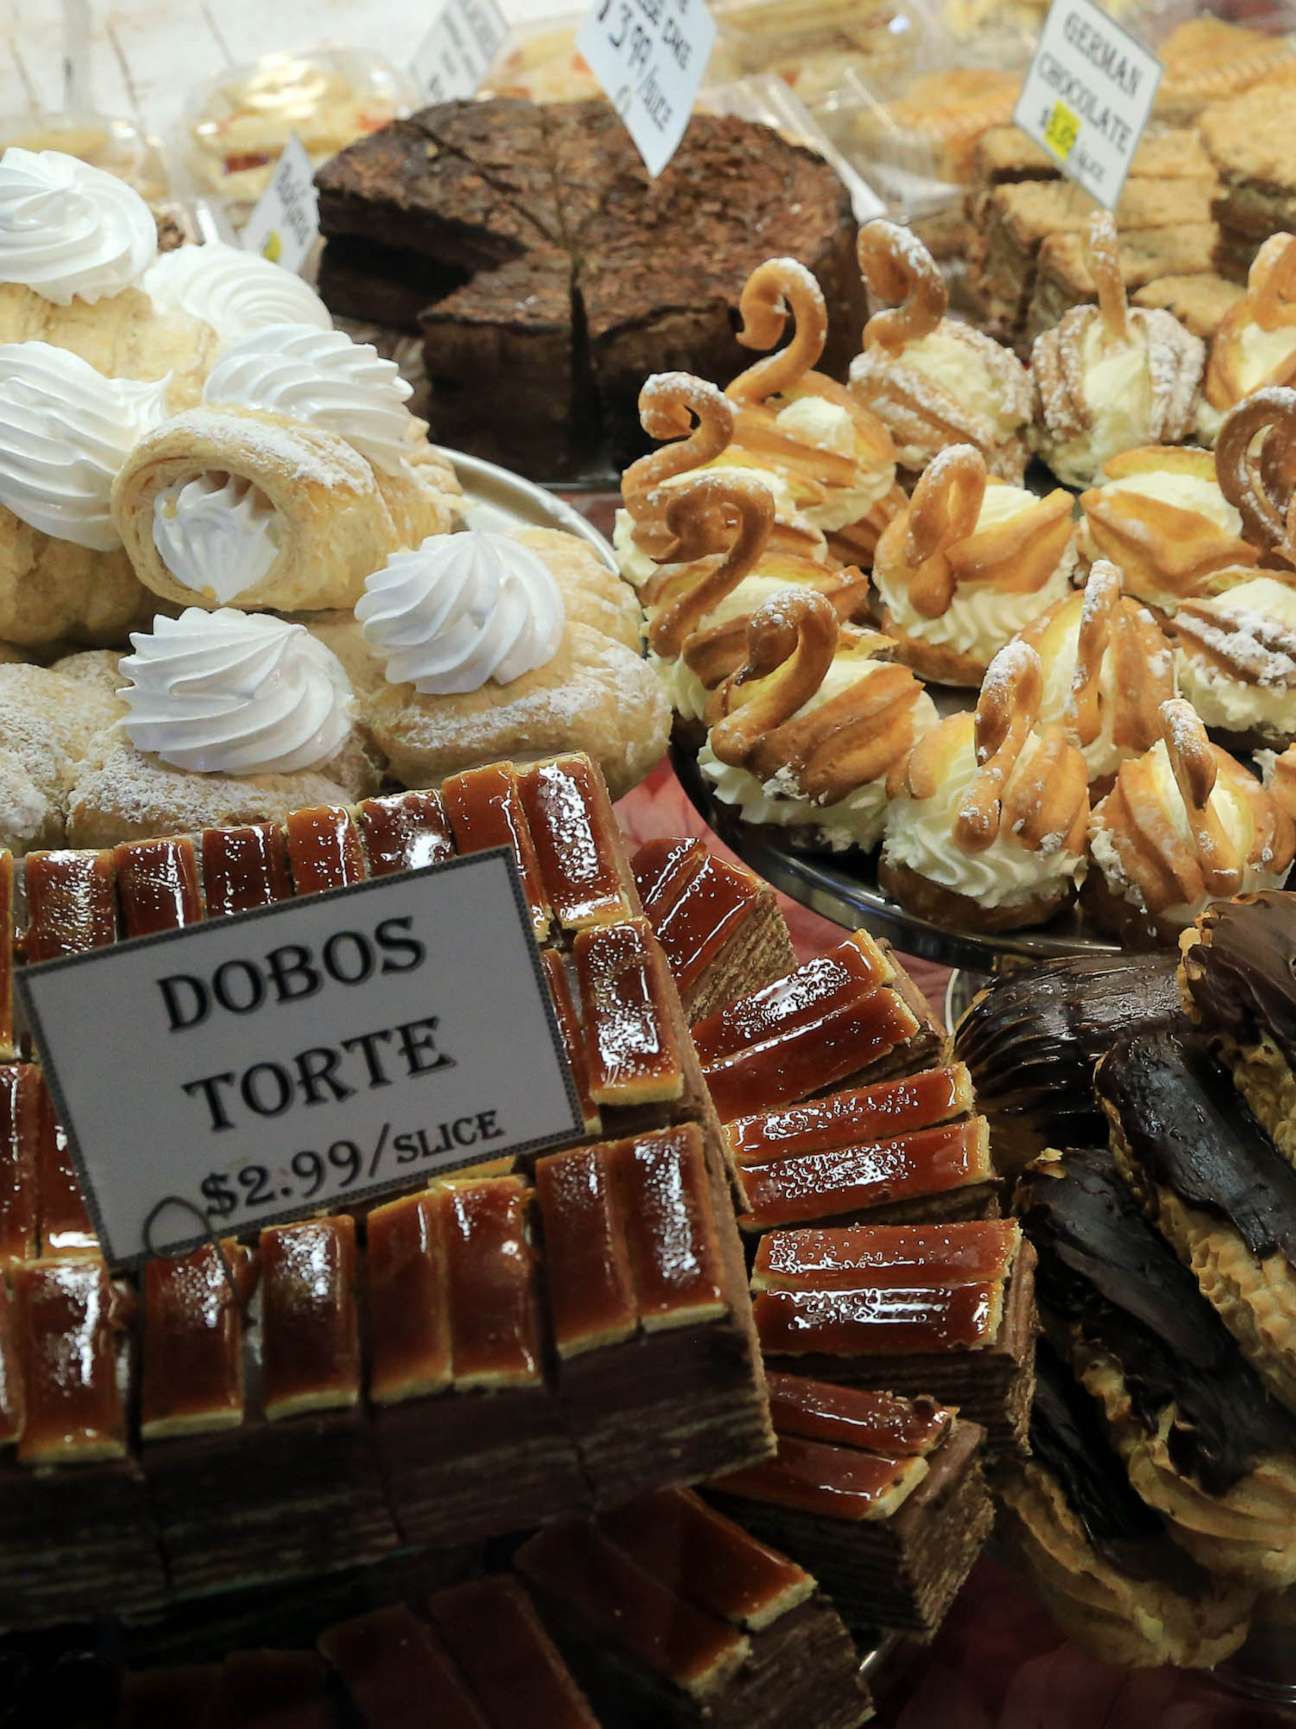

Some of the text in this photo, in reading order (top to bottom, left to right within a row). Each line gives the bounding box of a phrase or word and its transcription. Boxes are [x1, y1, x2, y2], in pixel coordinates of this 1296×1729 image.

[1037, 51, 1133, 156] CHOCOLATE
[1063, 11, 1143, 97] GERMAN
[156, 915, 428, 1033] DOBOS
[181, 1016, 457, 1134] TORTE
[201, 1109, 505, 1219] $2.99/SLICE
